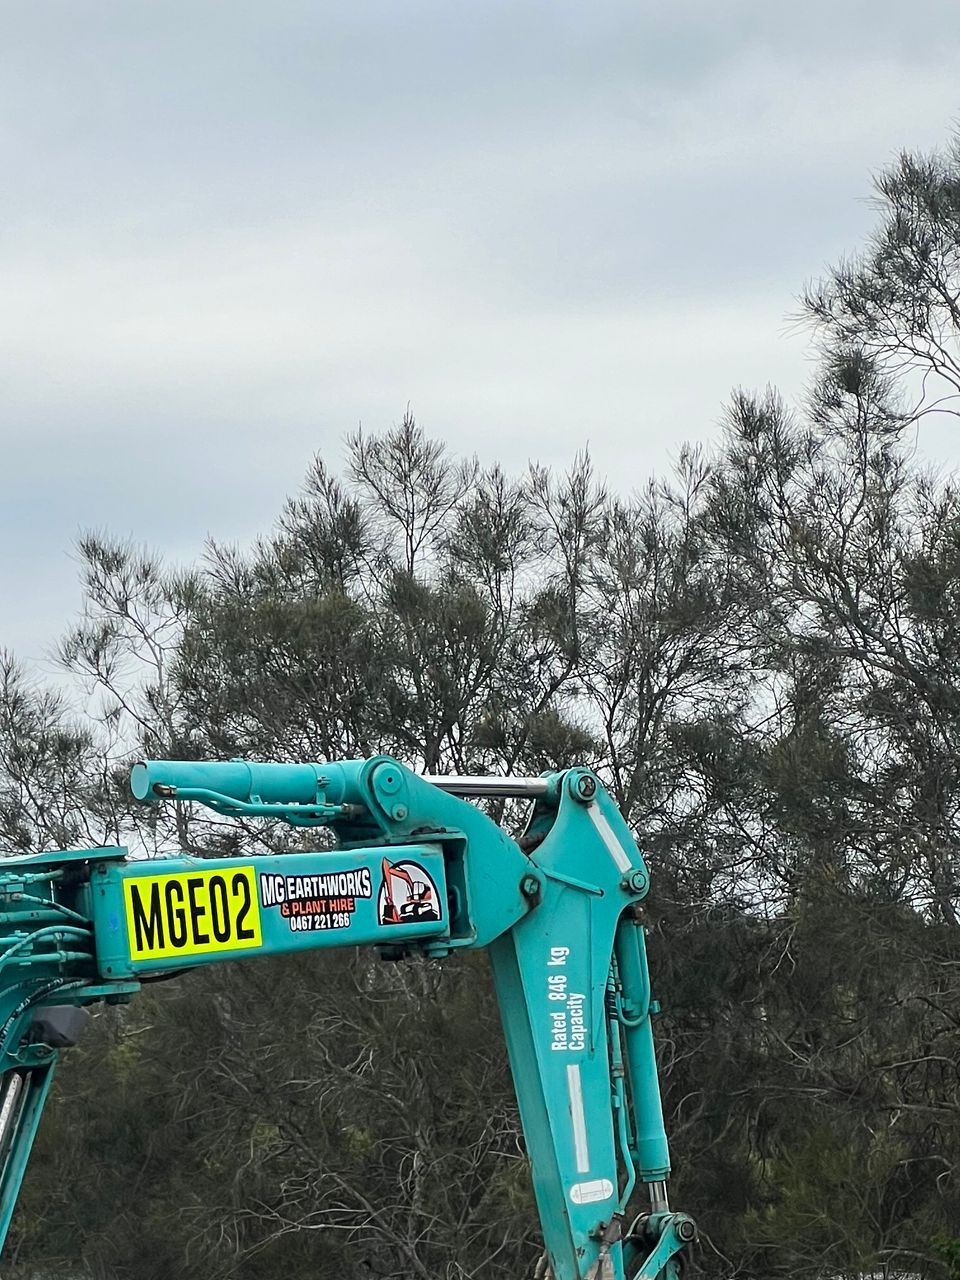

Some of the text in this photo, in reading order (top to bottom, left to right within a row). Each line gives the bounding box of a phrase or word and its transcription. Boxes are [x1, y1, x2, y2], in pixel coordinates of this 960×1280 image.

[261, 869, 371, 906] MG EARTHWORKS
[282, 898, 354, 916] & PLANT HIRE
[130, 873, 255, 952] MGE02
[290, 913, 349, 931] 0467 221 266
[547, 947, 569, 1050] Rated 846 kg
[567, 993, 587, 1051] Capacity
